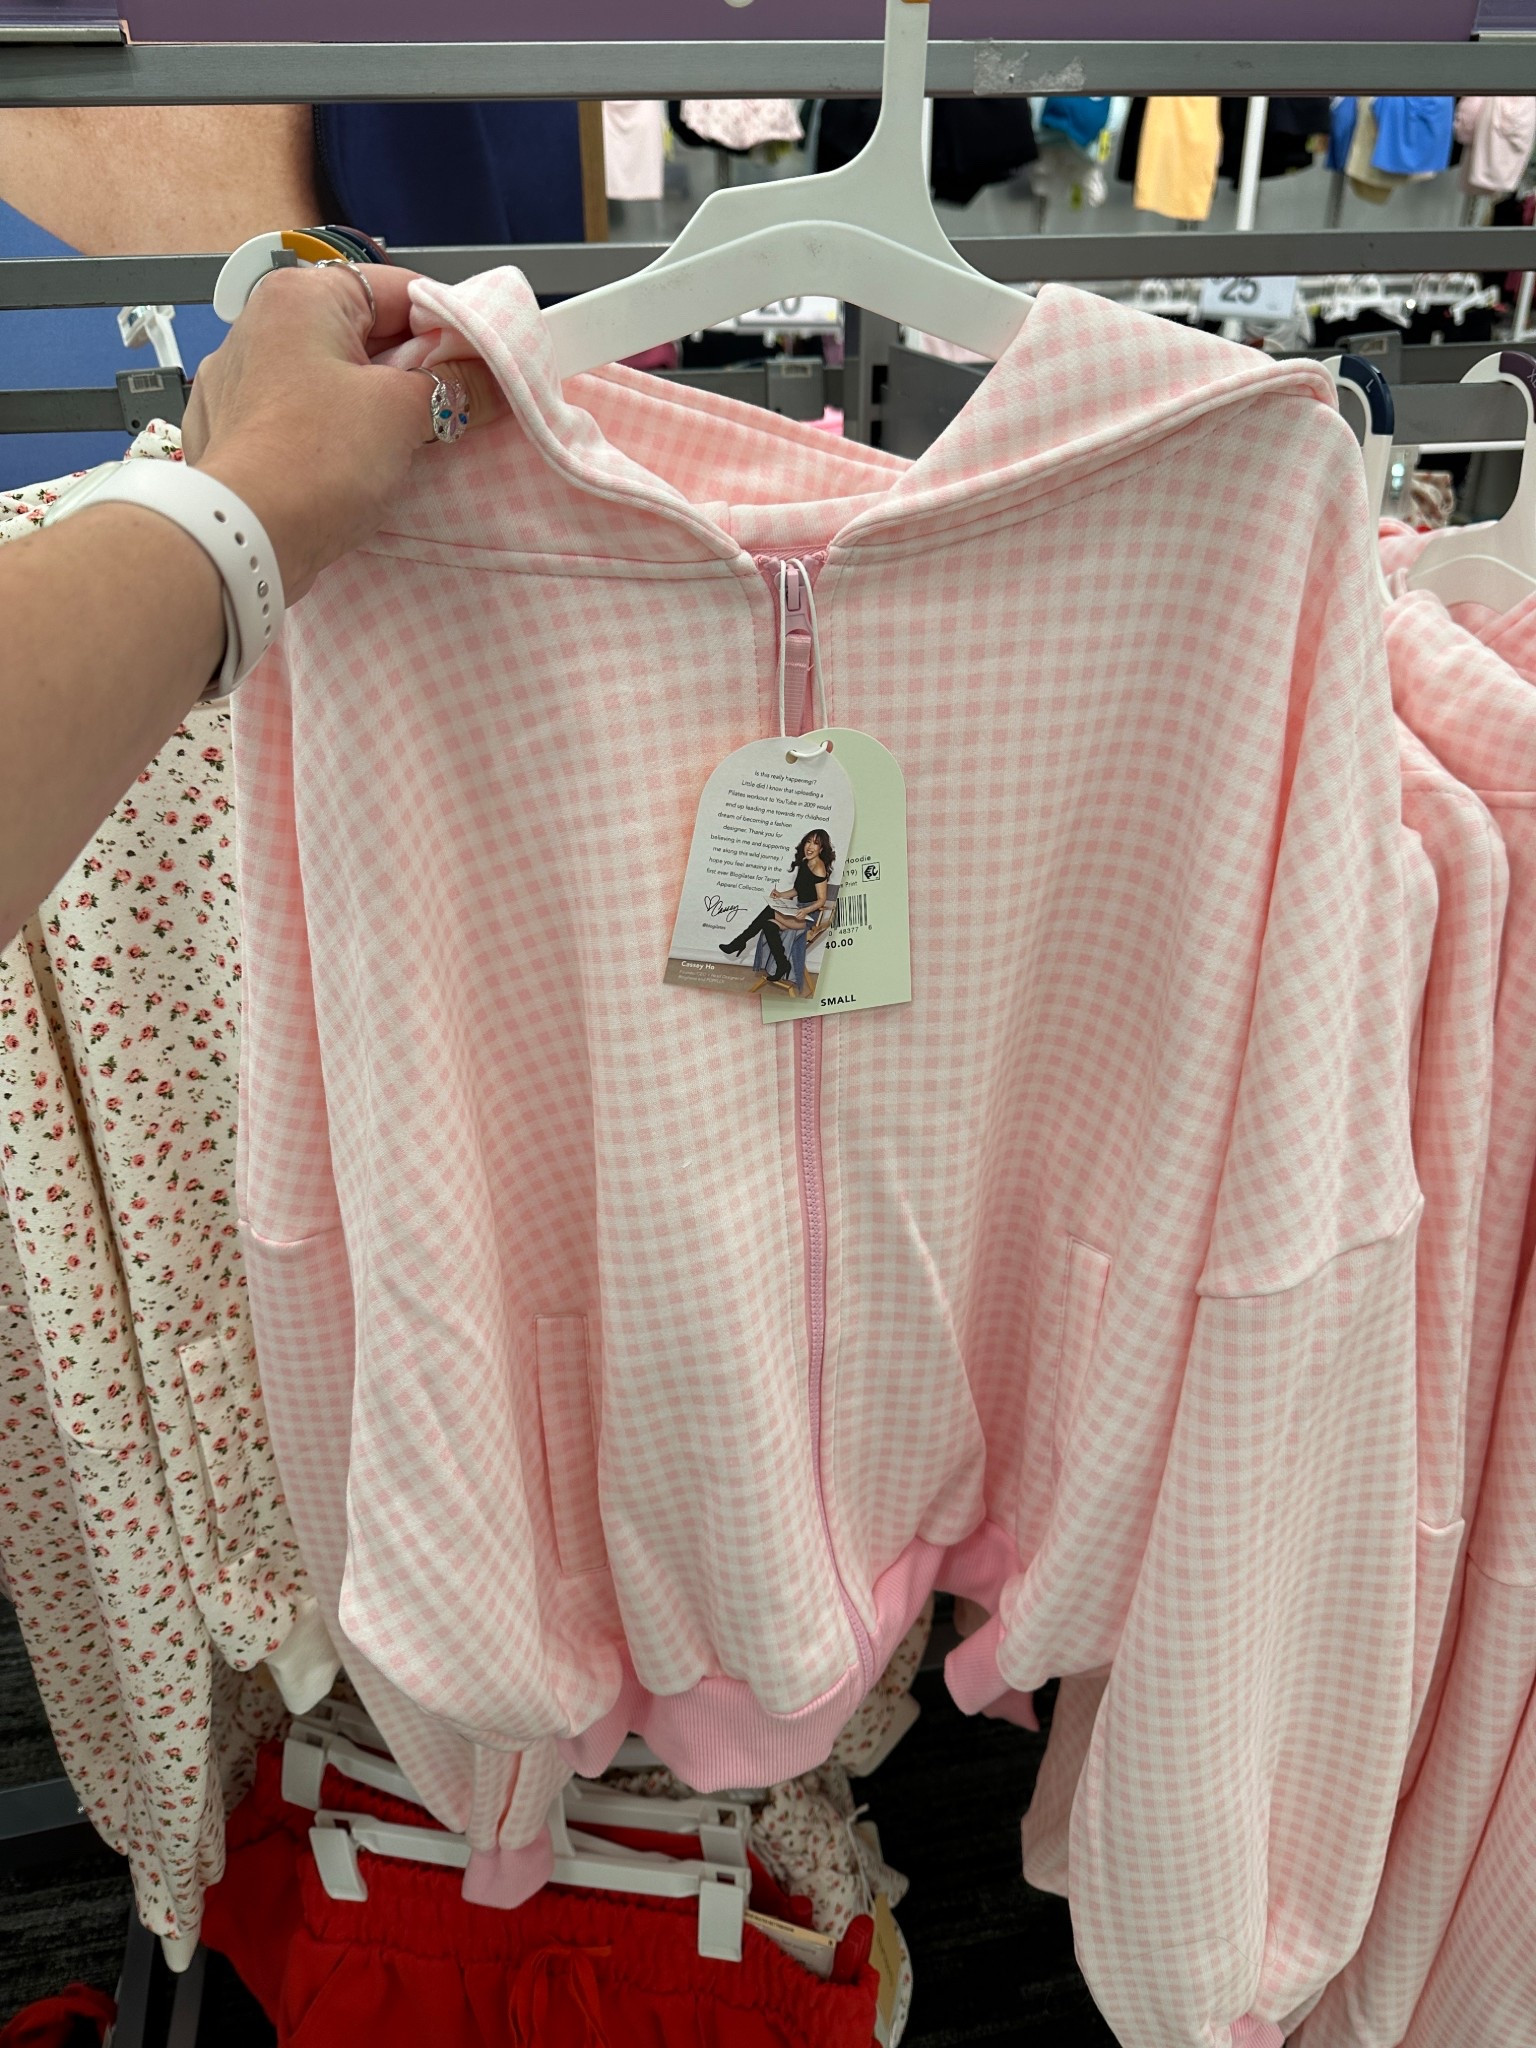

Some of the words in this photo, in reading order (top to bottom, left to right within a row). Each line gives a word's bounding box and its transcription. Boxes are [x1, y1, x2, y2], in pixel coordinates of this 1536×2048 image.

[1365, 379, 1375, 393] L
[770, 774, 785, 782] really
[741, 779, 755, 788] Little
[794, 790, 820, 799] uploading
[728, 789, 746, 798] Pilates
[746, 794, 769, 802] workout
[776, 797, 798, 806] YouTube
[803, 801, 816, 809] 2009
[745, 805, 766, 815] leading
[775, 810, 796, 818] towards
[804, 813, 830, 822] childhood
[742, 816, 769, 826] becoming
[711, 834, 735, 843] believing
[762, 843, 790, 851] supporting
[746, 863, 767, 871] amazing
[730, 871, 755, 880] Blogilates
[717, 881, 737, 889] Apparel
[681, 960, 704, 970] Cassey
[820, 994, 857, 1007] SMALL
